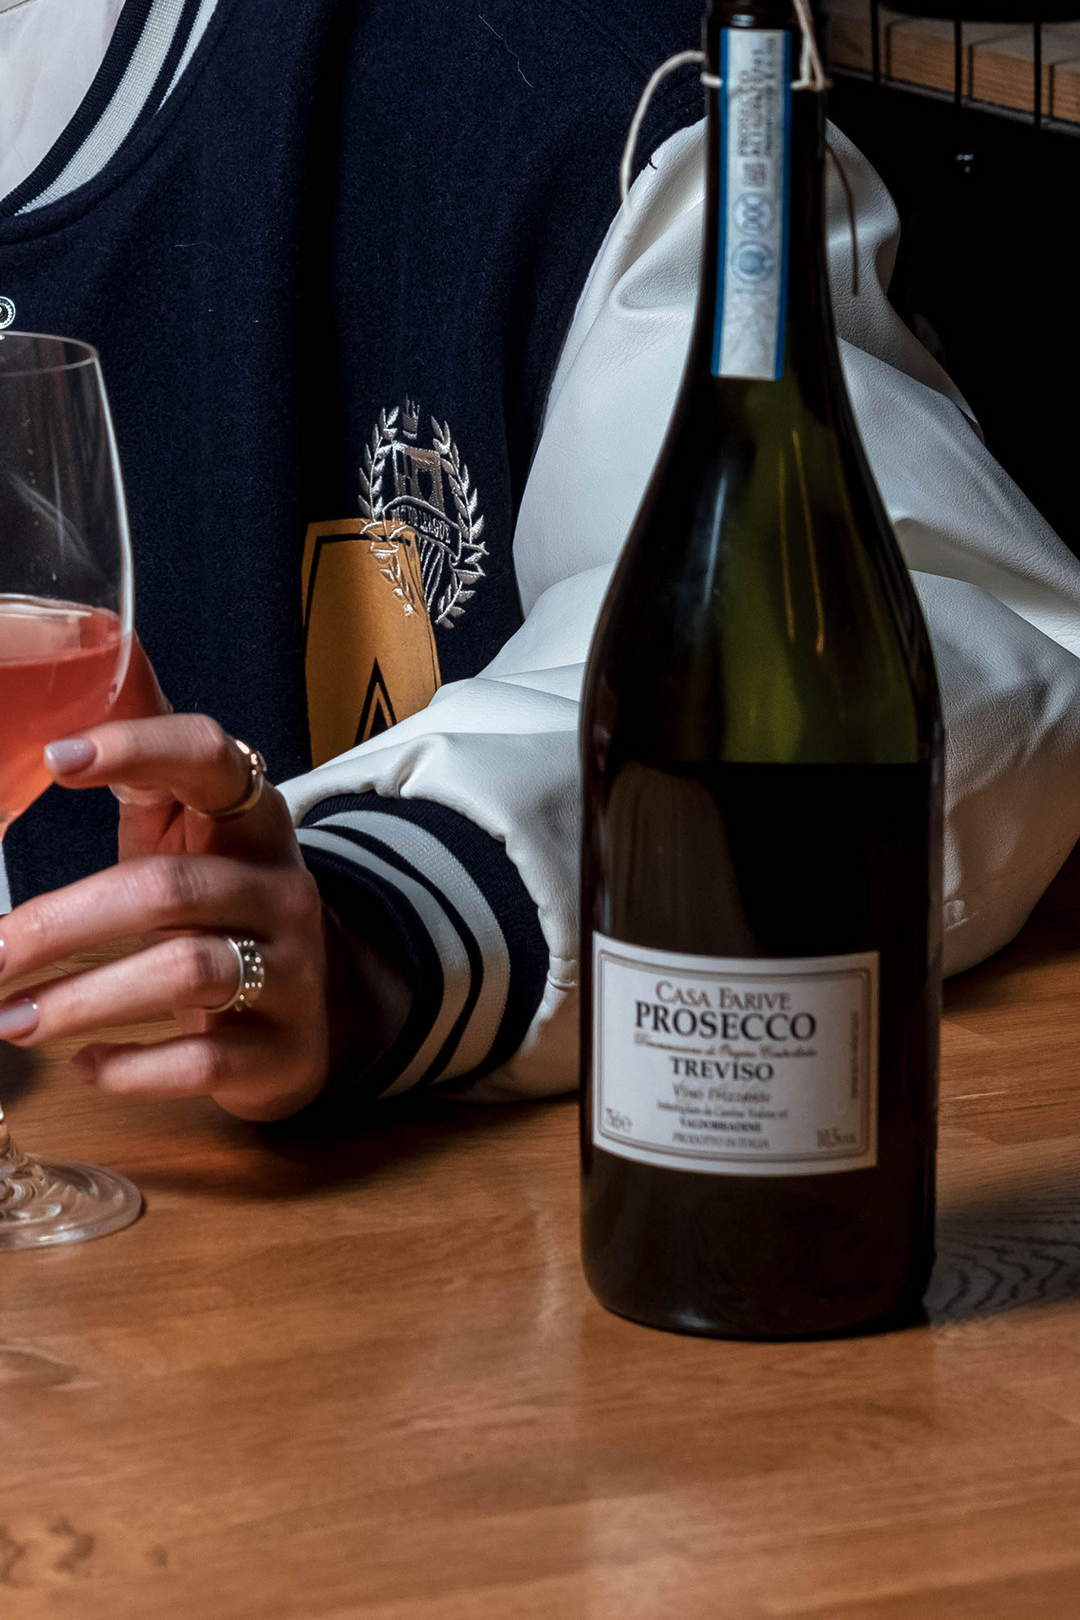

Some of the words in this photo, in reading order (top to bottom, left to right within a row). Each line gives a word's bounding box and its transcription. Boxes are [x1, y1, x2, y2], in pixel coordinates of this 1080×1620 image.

[655, 980, 710, 1009] CASA
[719, 987, 792, 1012] FARIVE
[635, 1000, 817, 1042] PROSECCO
[669, 1056, 775, 1082] TREVISO
